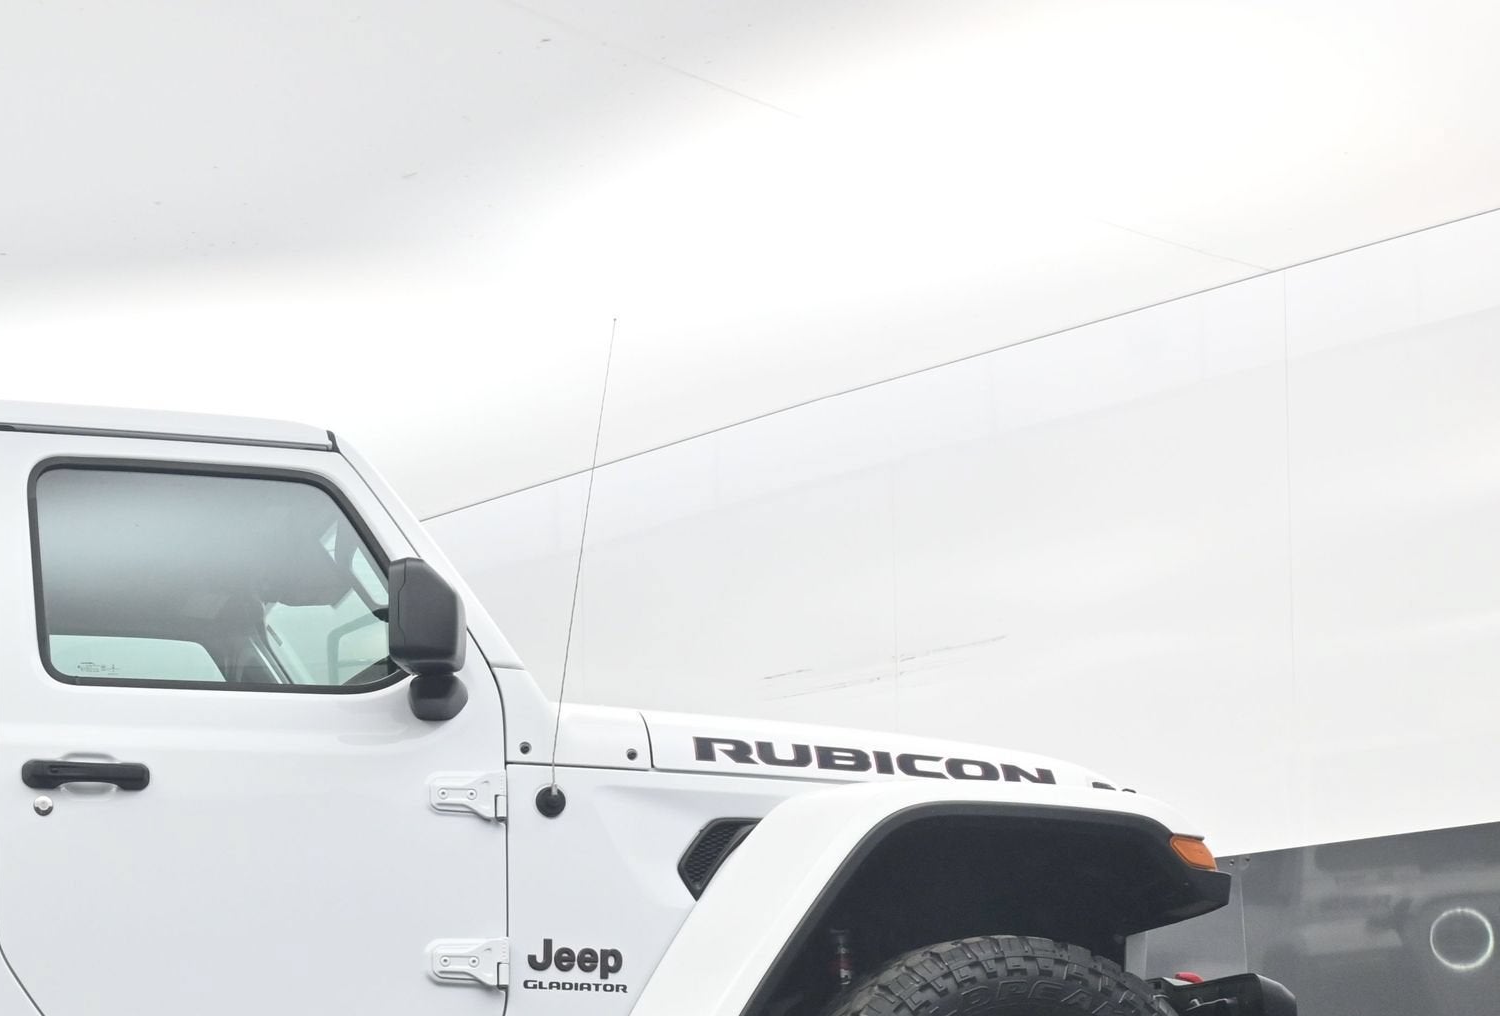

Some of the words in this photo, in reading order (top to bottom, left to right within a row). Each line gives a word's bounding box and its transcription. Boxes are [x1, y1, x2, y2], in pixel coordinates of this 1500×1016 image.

[693, 735, 1056, 784] RUBICON
[527, 938, 623, 980] Jeep
[523, 980, 628, 993] GLADIATOR
